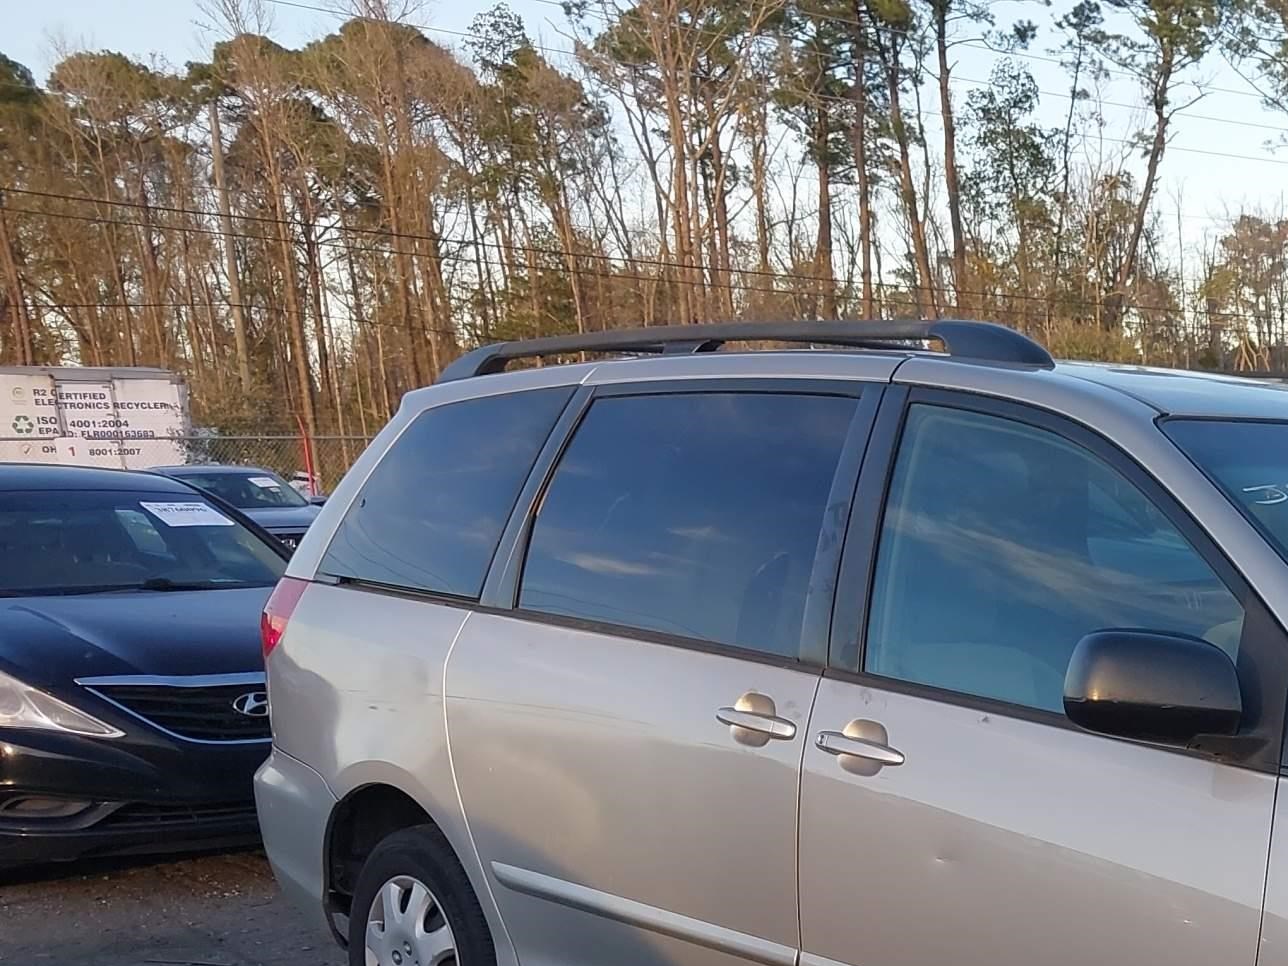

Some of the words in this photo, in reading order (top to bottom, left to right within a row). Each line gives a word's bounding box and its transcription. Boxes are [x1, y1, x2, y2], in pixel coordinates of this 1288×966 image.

[33, 388, 47, 396] R2
[37, 416, 57, 425] ISO
[39, 427, 60, 435] EPA
